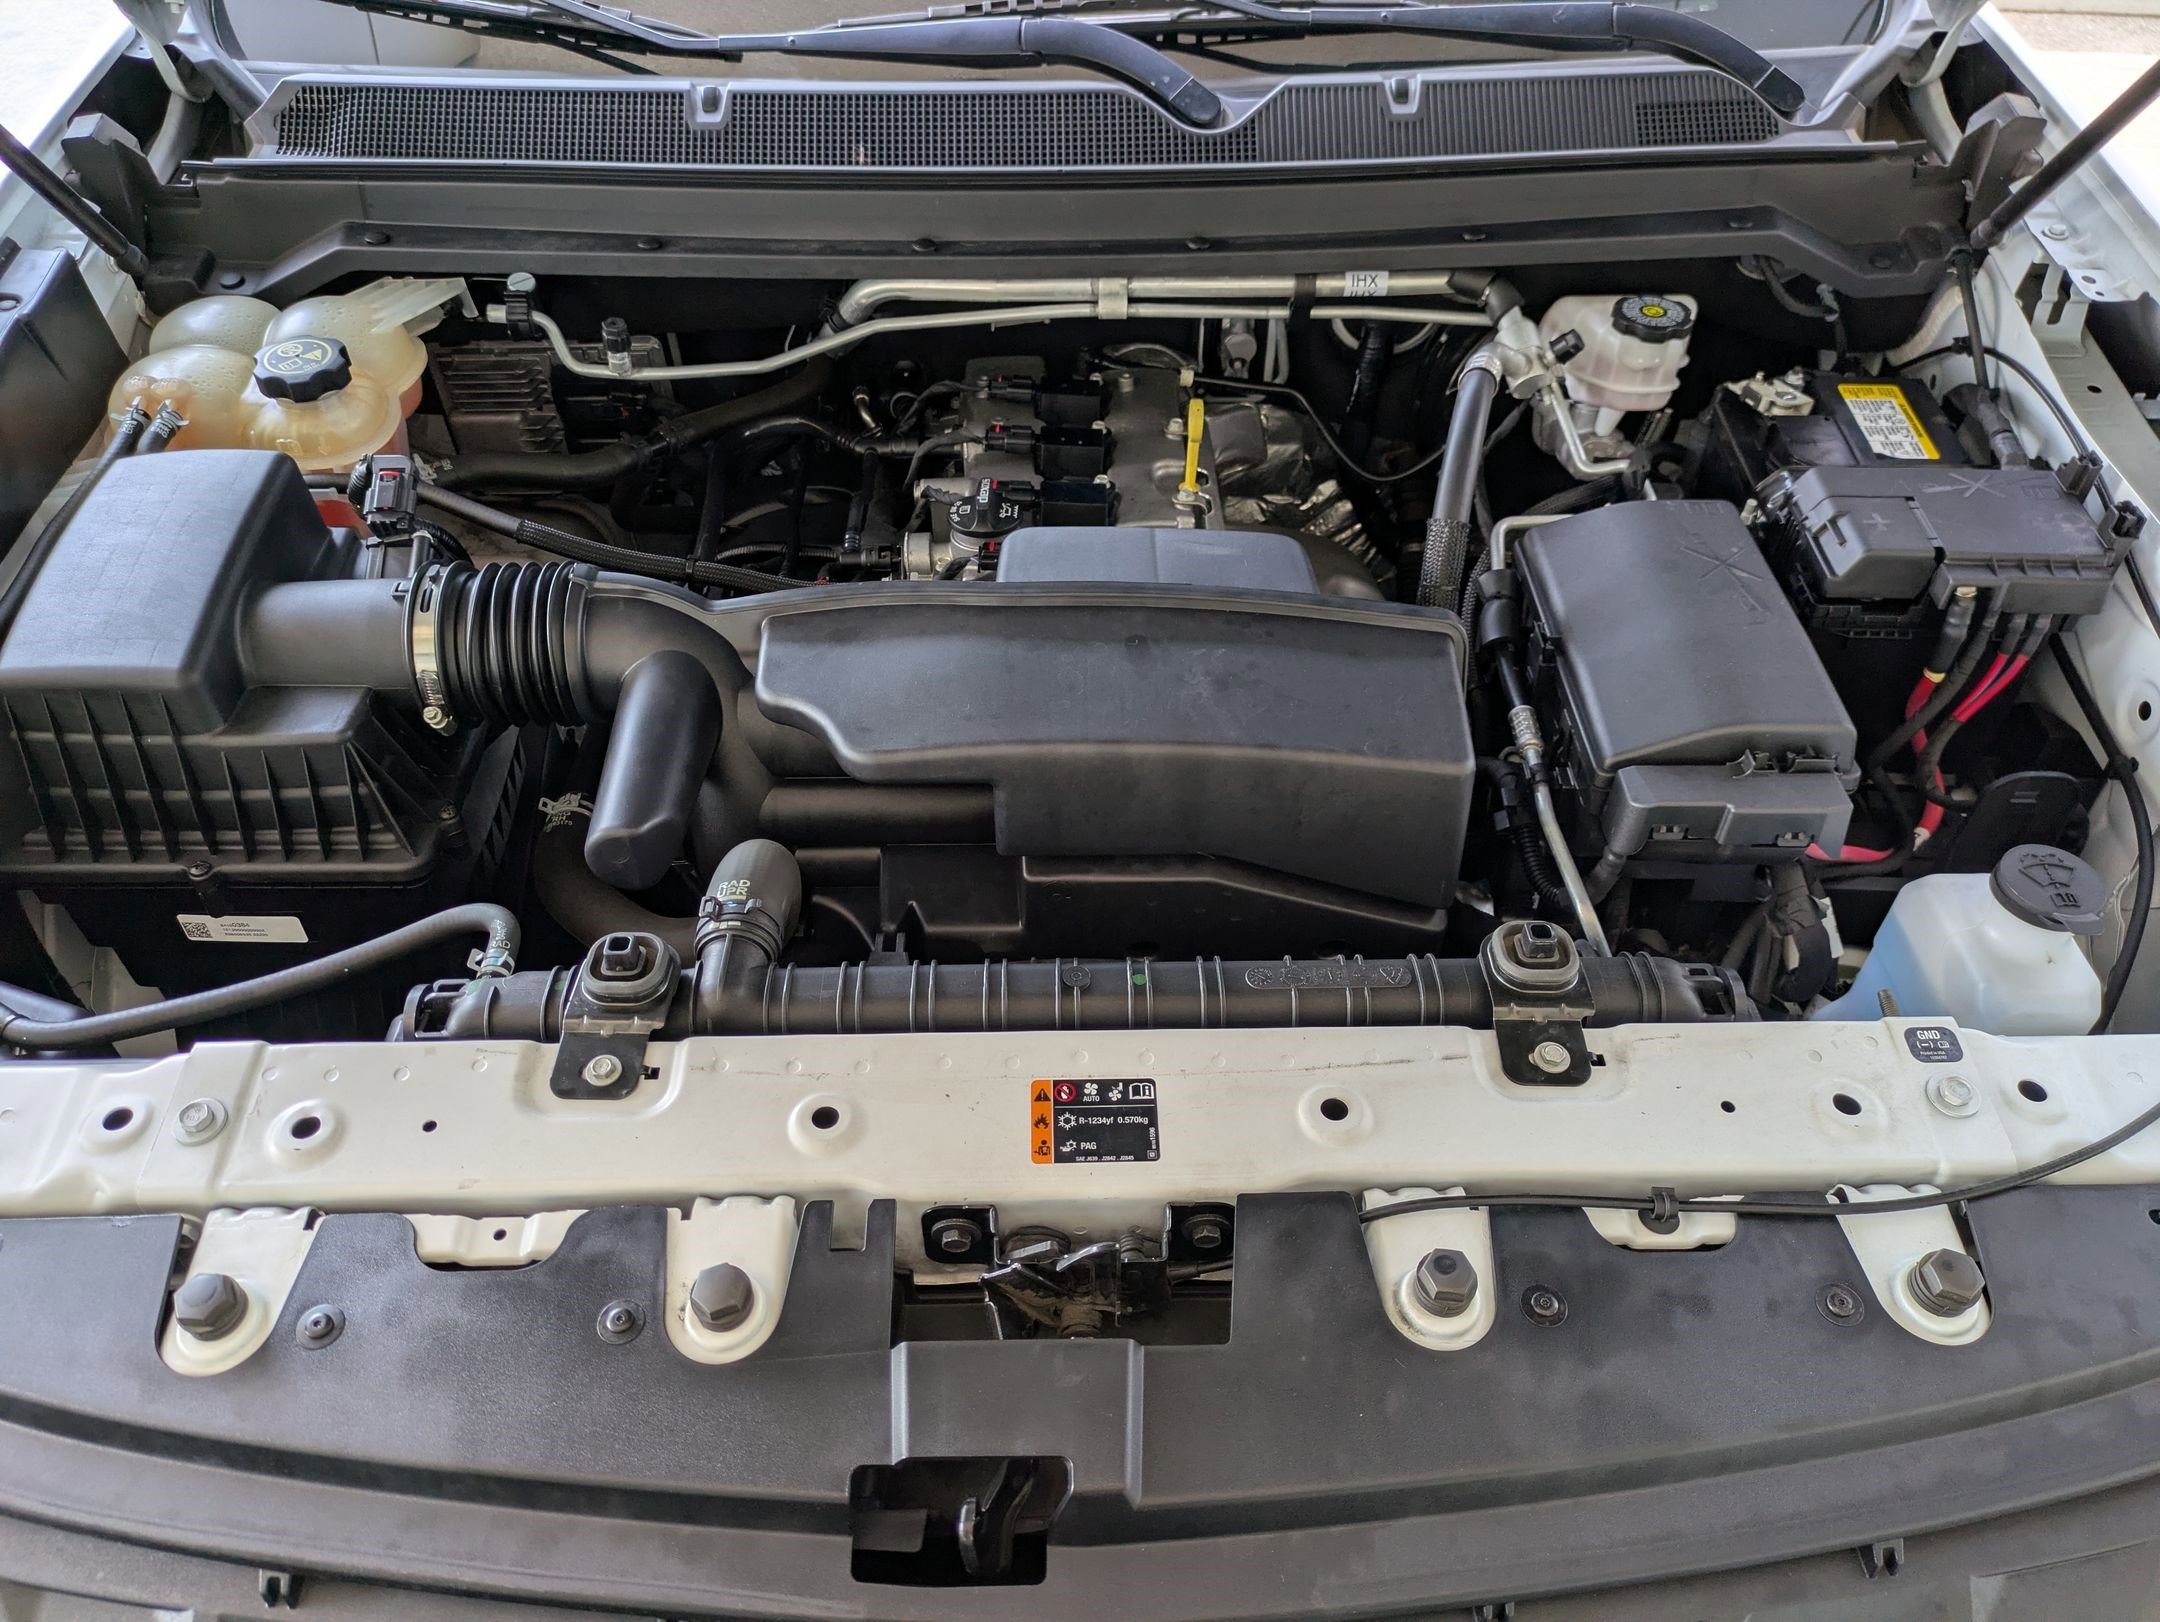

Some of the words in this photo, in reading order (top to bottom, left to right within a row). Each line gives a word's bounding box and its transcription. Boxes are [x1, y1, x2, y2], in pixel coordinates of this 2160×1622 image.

[1351, 273, 1379, 288] IHX
[719, 879, 751, 889] RAD
[717, 886, 748, 898] UPR
[1916, 1030, 1941, 1040] GND
[1078, 1116, 1114, 1126] R-1234yf
[1117, 1116, 1149, 1125] 0.570kg
[1080, 1142, 1097, 1150] PAG
